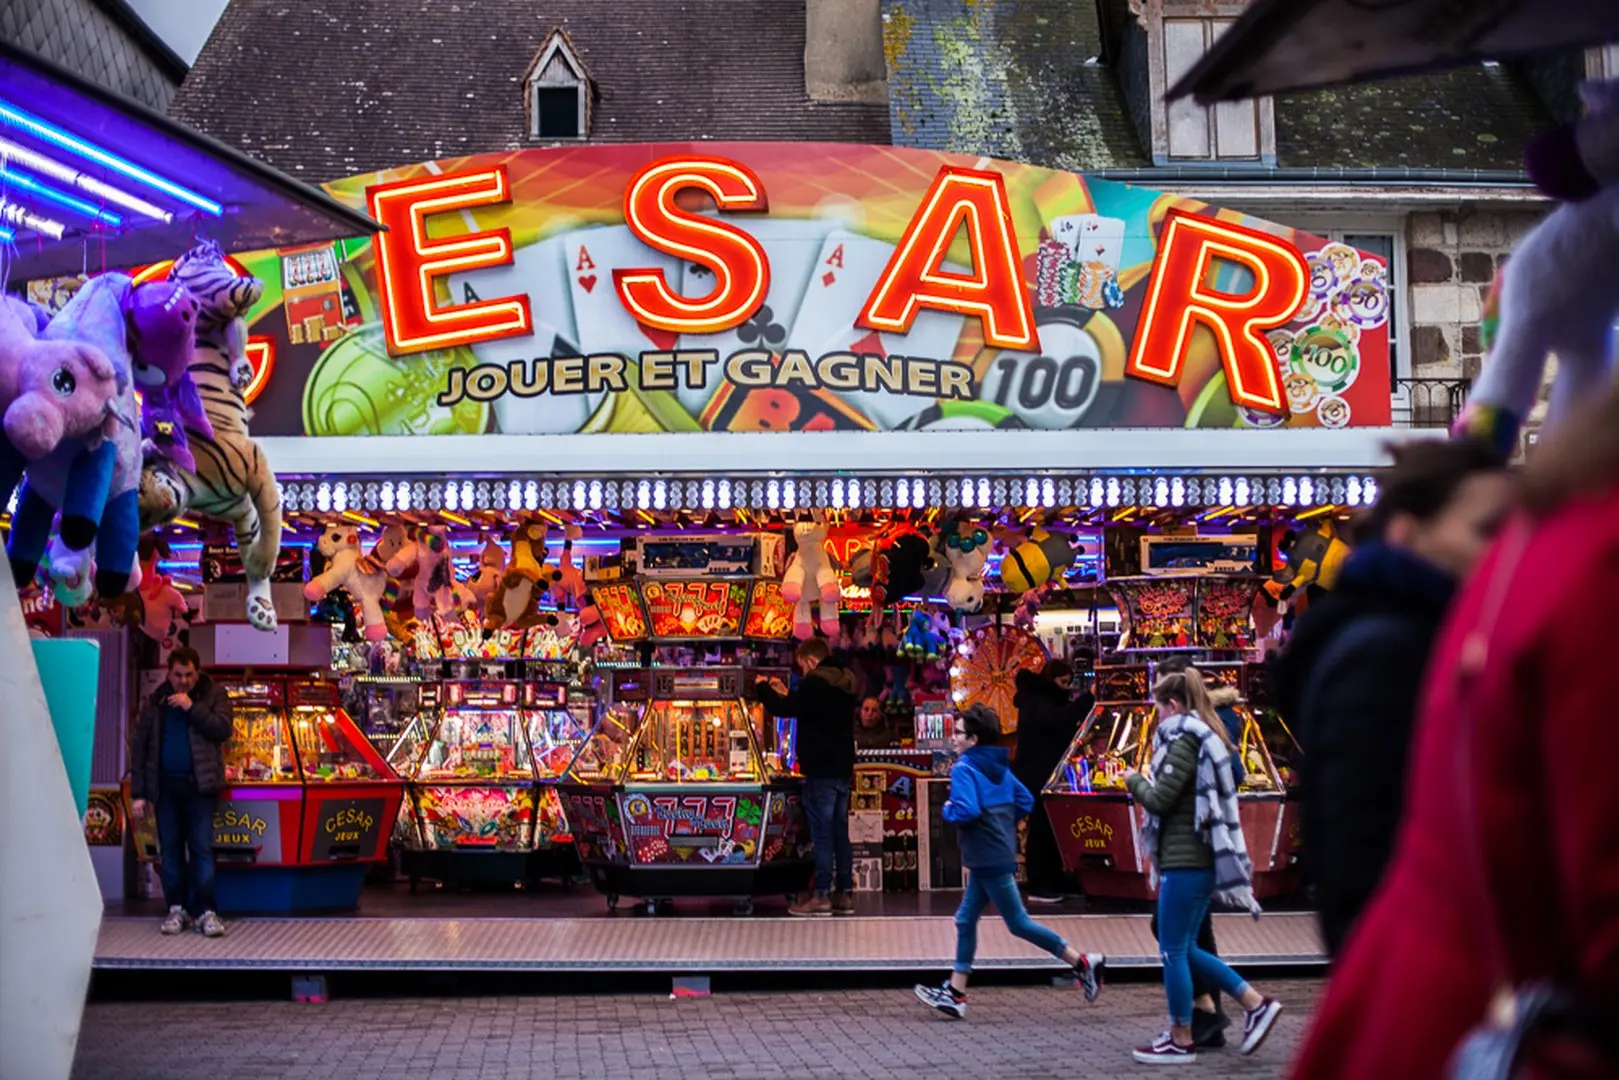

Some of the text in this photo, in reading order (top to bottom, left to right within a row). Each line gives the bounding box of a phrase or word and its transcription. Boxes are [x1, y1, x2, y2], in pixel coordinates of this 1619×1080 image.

[576, 244, 596, 271] A
[826, 243, 845, 269] A
[128, 155, 1312, 419] ESAR
[1307, 343, 1348, 374] 100
[440, 349, 975, 406] JOUER ET GAGNER
[993, 355, 1097, 410] 100
[212, 810, 268, 837] ESAR
[325, 807, 374, 833] CESAR
[1070, 816, 1114, 841] CESAR
[215, 833, 250, 844] JEUX
[335, 830, 360, 842] JEUX
